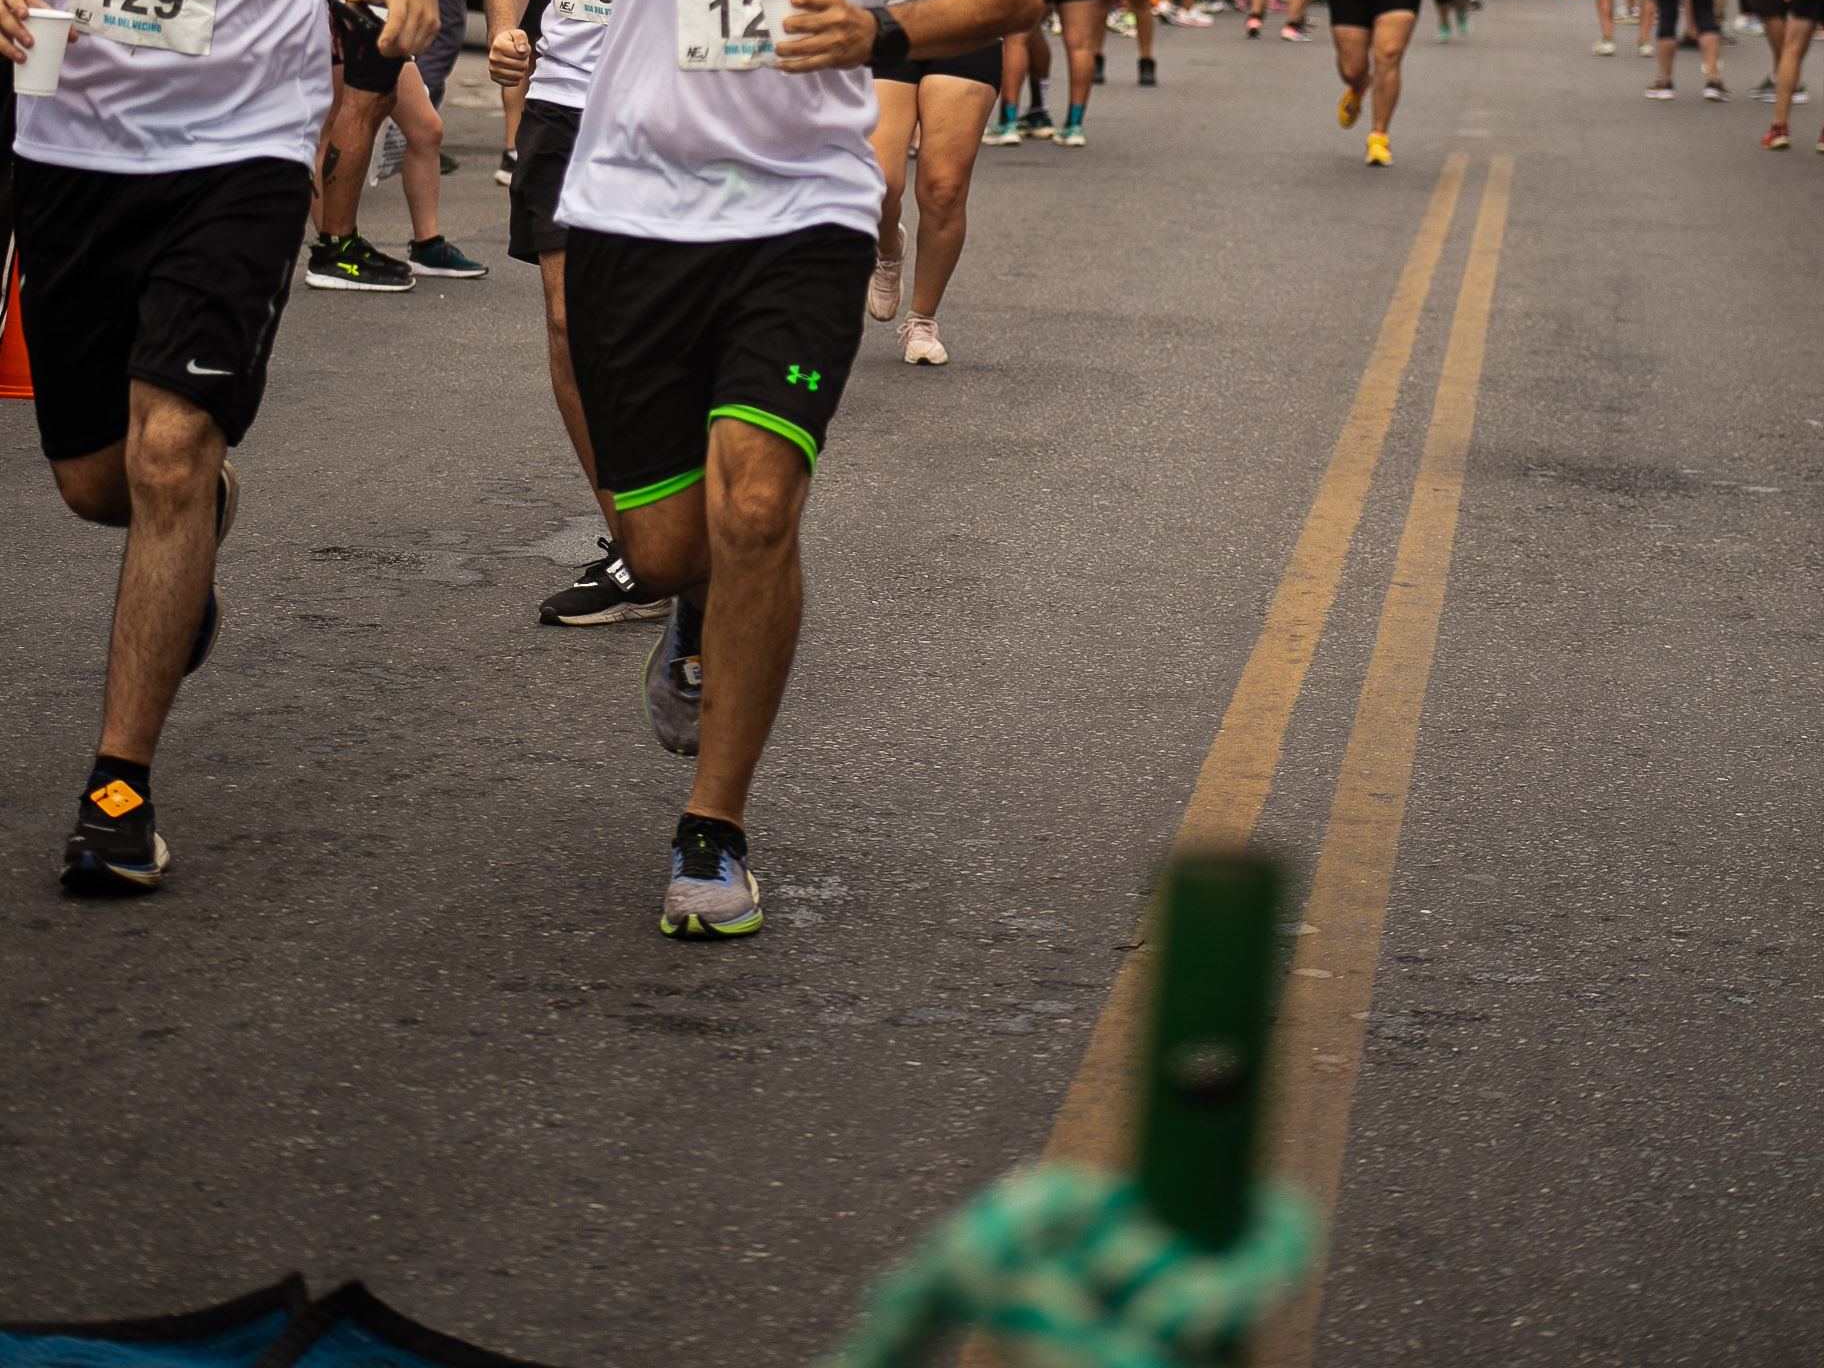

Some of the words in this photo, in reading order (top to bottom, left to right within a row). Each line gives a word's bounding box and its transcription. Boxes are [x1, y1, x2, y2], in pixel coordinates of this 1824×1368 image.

[560, 1, 575, 12] NEJ
[76, 8, 93, 23] NEJ
[687, 46, 709, 60] NEJ
